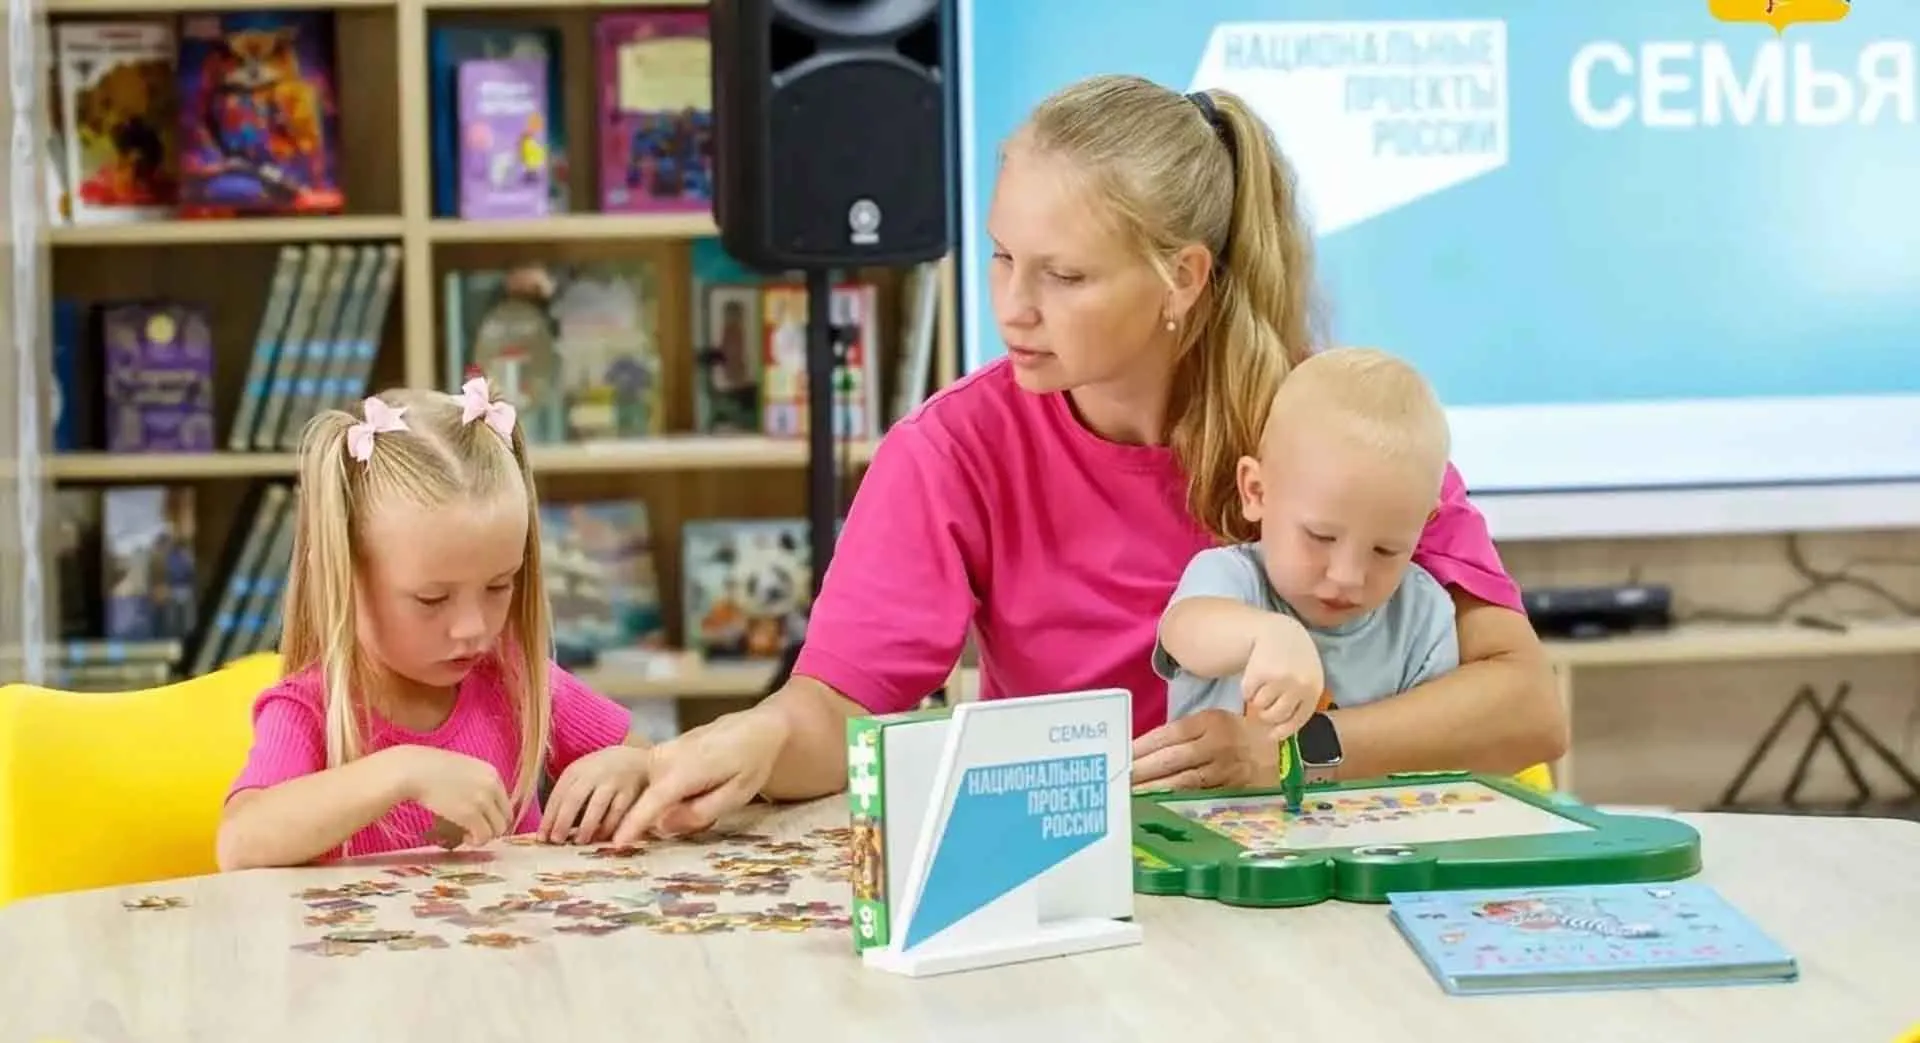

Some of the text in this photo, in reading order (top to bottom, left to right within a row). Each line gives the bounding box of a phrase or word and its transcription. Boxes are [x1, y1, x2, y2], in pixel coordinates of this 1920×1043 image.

[1224, 30, 1495, 71] НАЦИОНАЛЬНЫЕ
[1344, 73, 1498, 114] ПРОЕКТЫ
[1569, 38, 1917, 131] СЕМЬЯ
[1372, 117, 1498, 157] РОССИИ
[1048, 721, 1108, 743] СЕМЬЯ
[967, 756, 1105, 796] НАЦИОНАЛЬНЫЕ
[1027, 782, 1105, 816] ПРОЕКТЫ
[1041, 808, 1105, 840] РОССИИ
